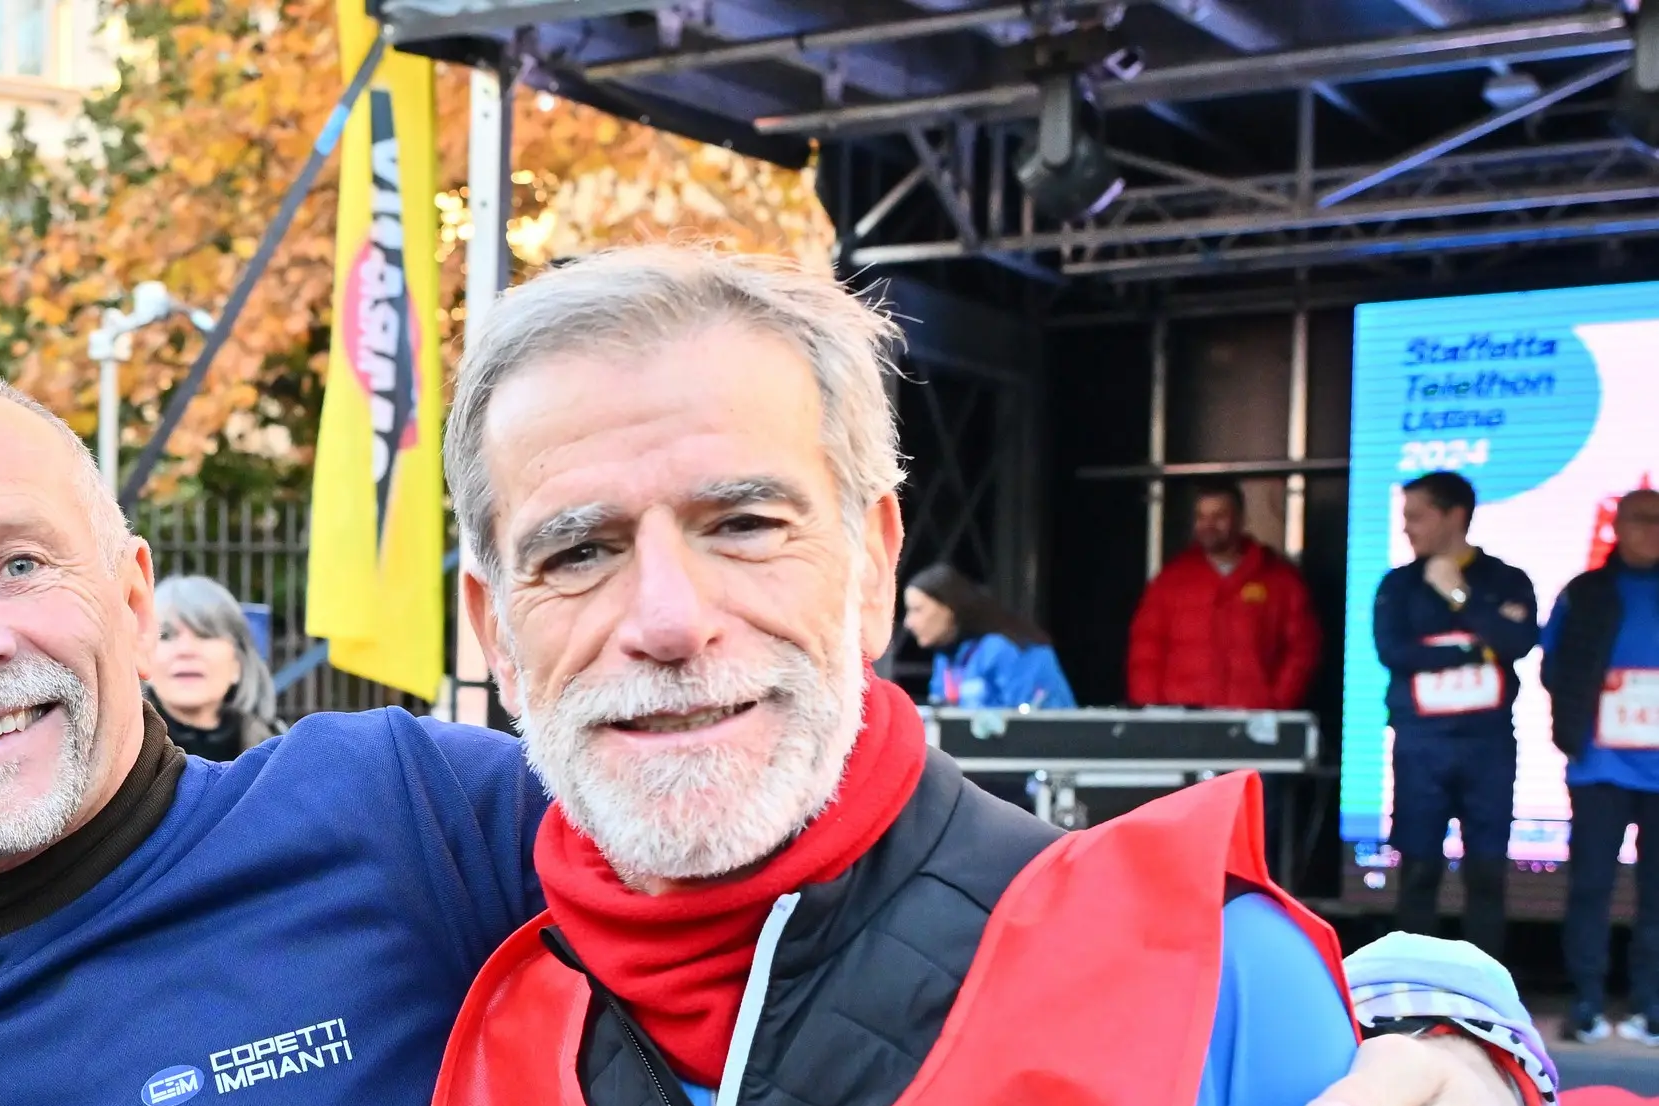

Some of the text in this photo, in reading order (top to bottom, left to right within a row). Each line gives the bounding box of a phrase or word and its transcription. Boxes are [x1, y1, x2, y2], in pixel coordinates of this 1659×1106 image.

[1397, 437, 1489, 472] 2024
[209, 1018, 346, 1073] COPETTI
[214, 1040, 353, 1094] IMPIANTI
